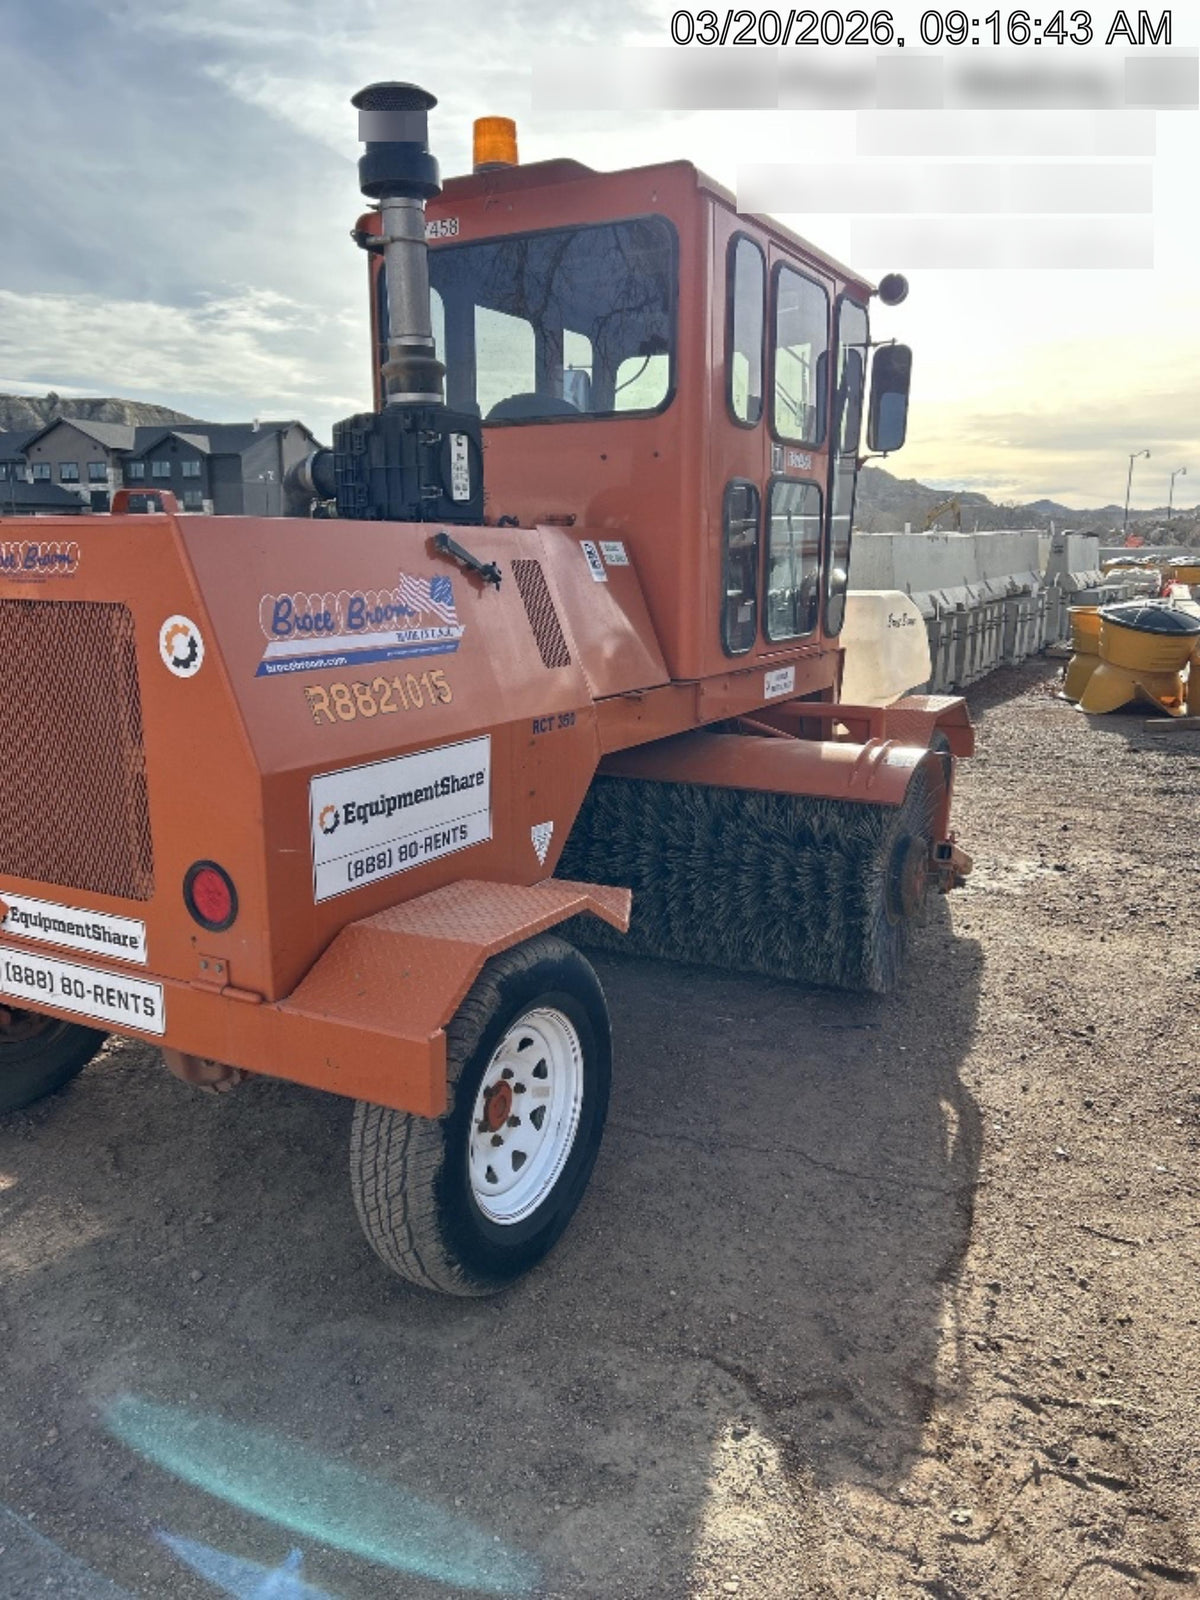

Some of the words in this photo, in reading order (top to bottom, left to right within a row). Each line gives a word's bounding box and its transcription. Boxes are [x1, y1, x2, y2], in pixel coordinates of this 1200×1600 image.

[24, 546, 73, 569] Broom
[271, 597, 335, 636] Broce
[347, 597, 417, 630] Broom
[304, 669, 453, 725] R8821015
[532, 715, 555, 734] RCT
[343, 772, 485, 825] EquipmentShare
[347, 849, 392, 882] (888)
[399, 824, 468, 863] 80-RENTS
[10, 906, 139, 949] EquipmentShare
[5, 961, 54, 993] (888)
[61, 975, 155, 1017] 80-RENTS
